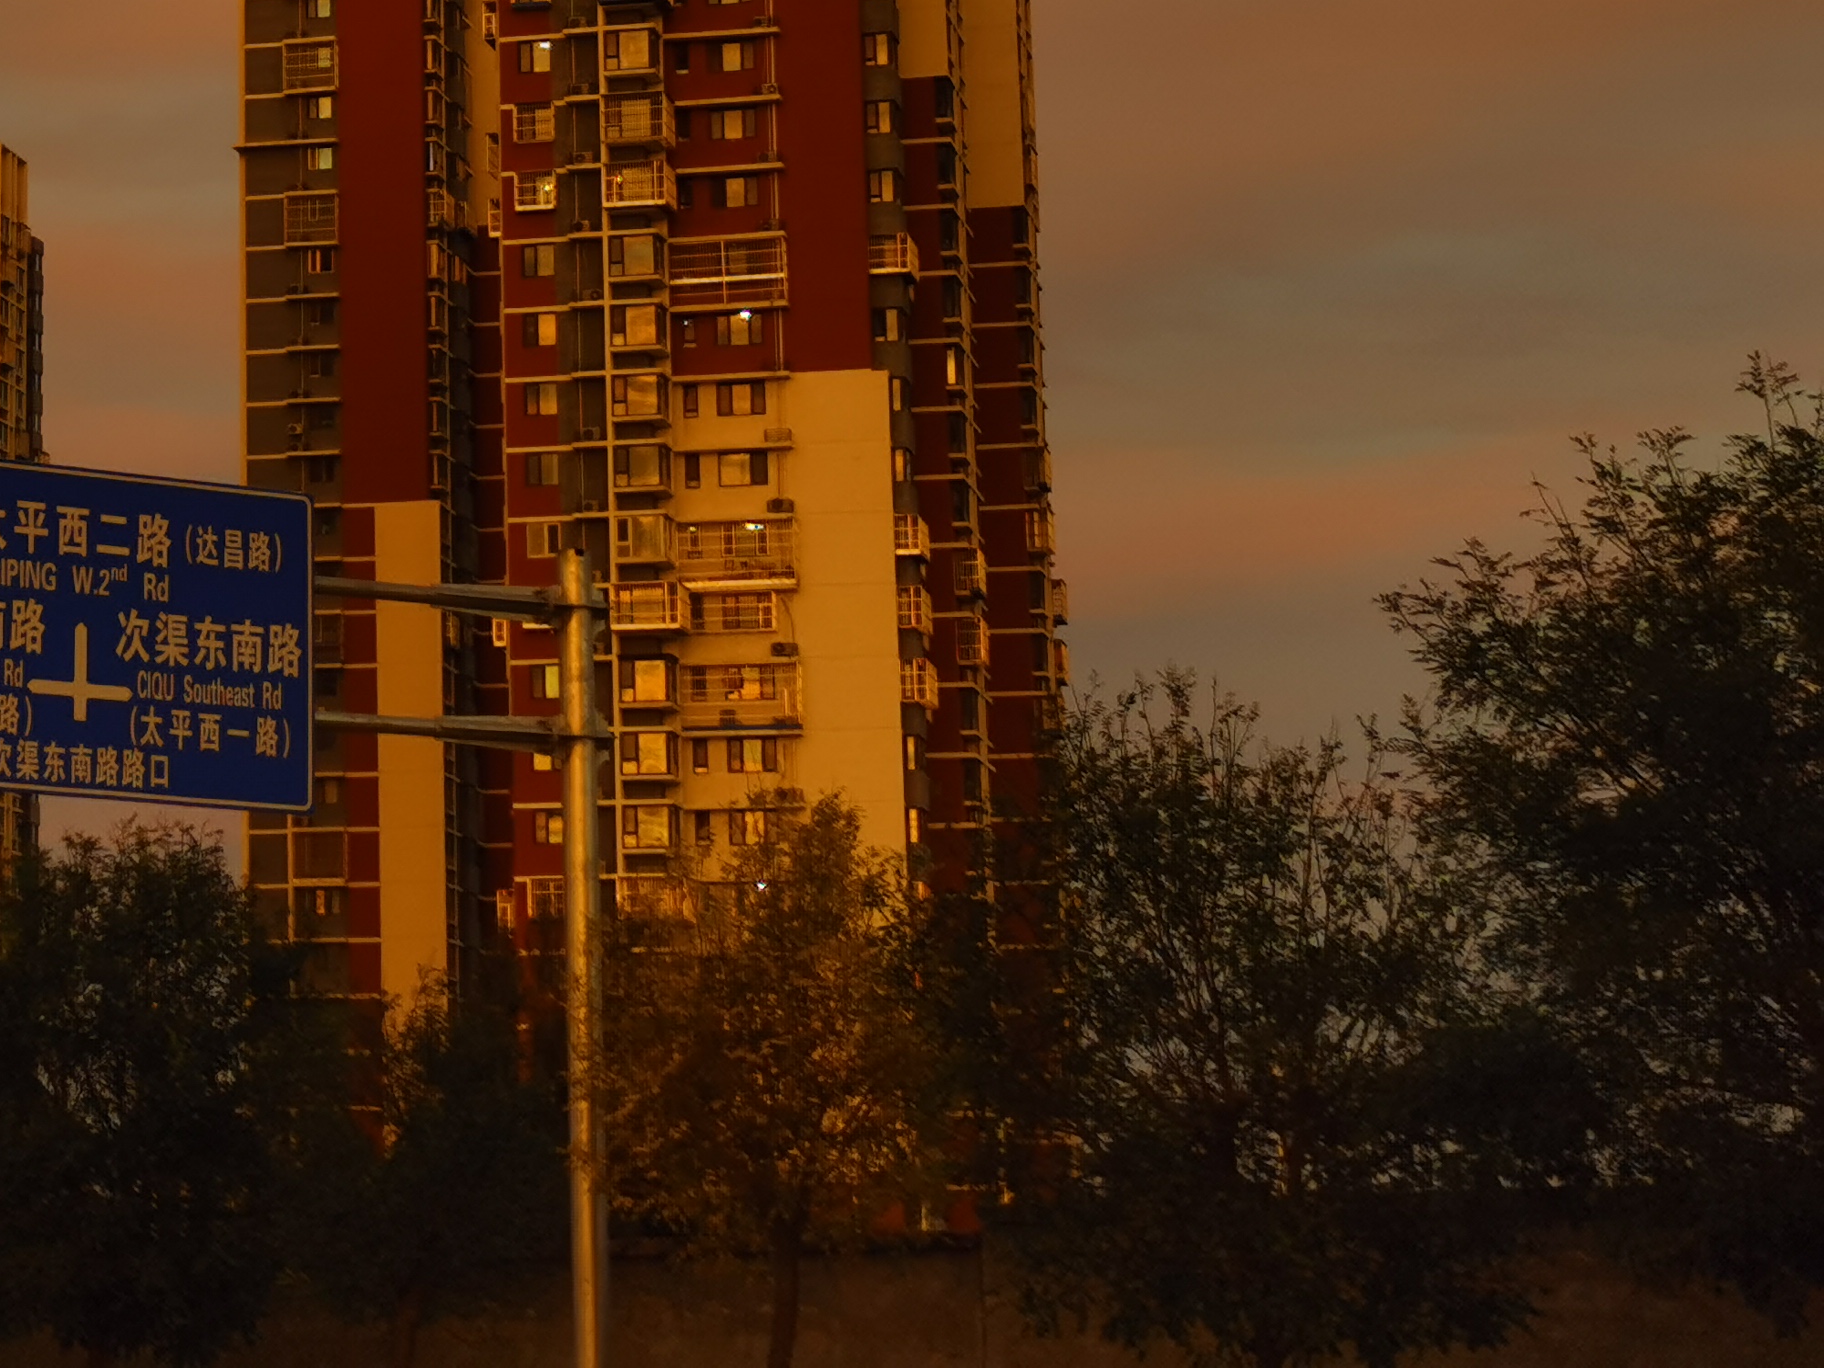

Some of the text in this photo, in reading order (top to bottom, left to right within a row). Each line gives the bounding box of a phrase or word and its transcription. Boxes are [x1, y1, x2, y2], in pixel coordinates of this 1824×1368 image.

[185, 525, 282, 572] (达昌路)
[143, 572, 170, 603] Rd
[115, 608, 302, 678] 次渠东南路
[3, 658, 24, 688] Rd
[137, 669, 282, 710] CIQU Southeast Rd
[129, 705, 290, 759] (太平西一路)
